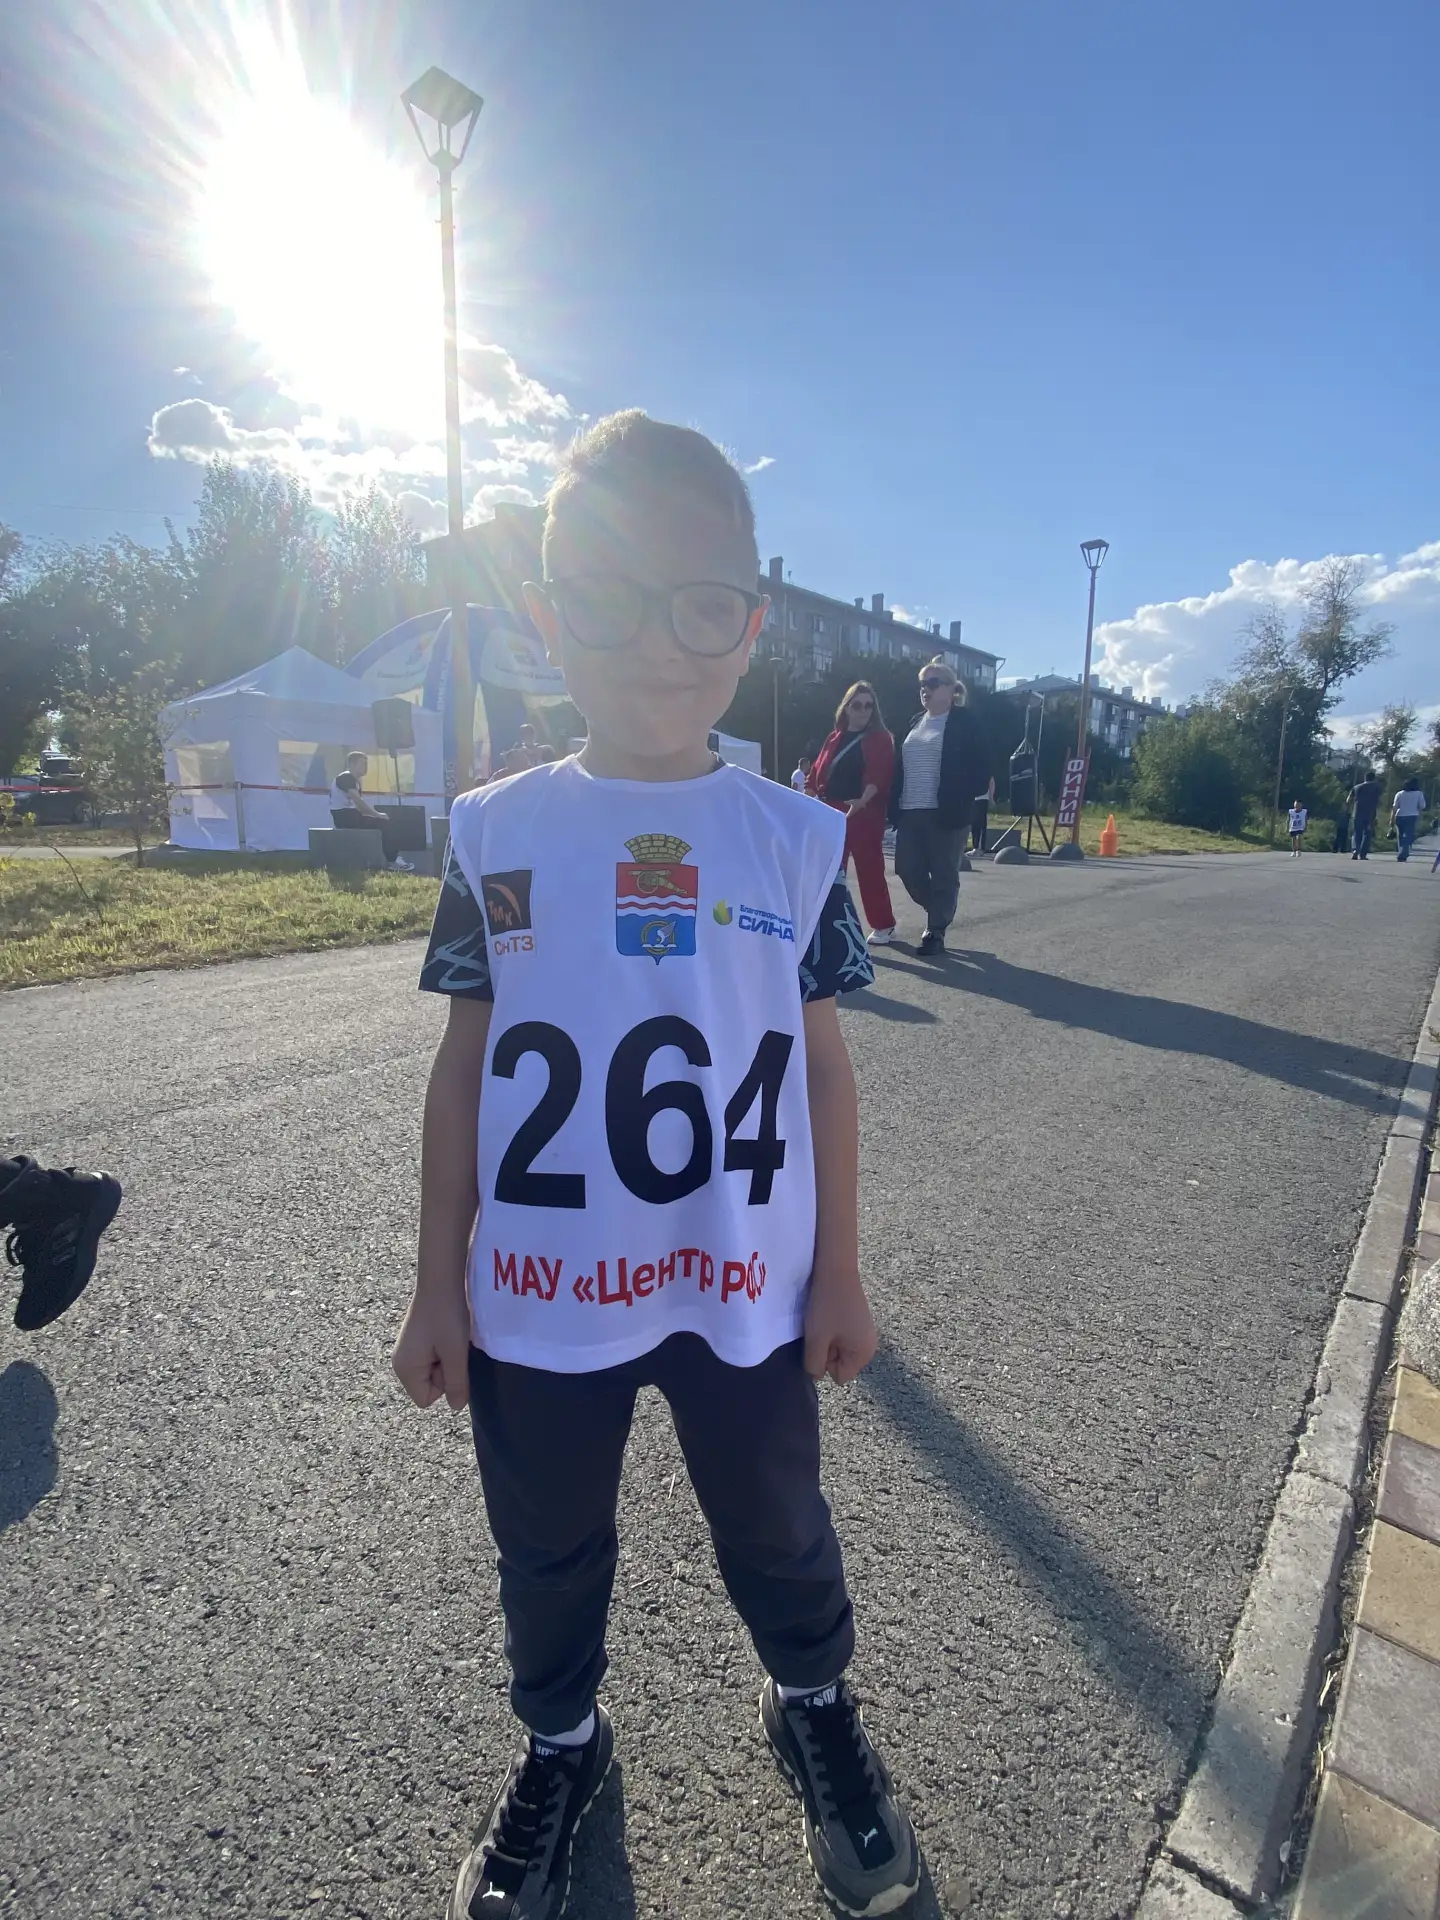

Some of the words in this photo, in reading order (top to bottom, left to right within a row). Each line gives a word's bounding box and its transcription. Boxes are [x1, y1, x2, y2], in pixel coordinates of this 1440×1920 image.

[1057, 758, 1085, 825] ФИНИШ
[487, 901, 512, 927] ТМК
[491, 1015, 794, 1209] 264
[494, 1248, 563, 1301] МАУ
[572, 1247, 714, 1307] «Центр
